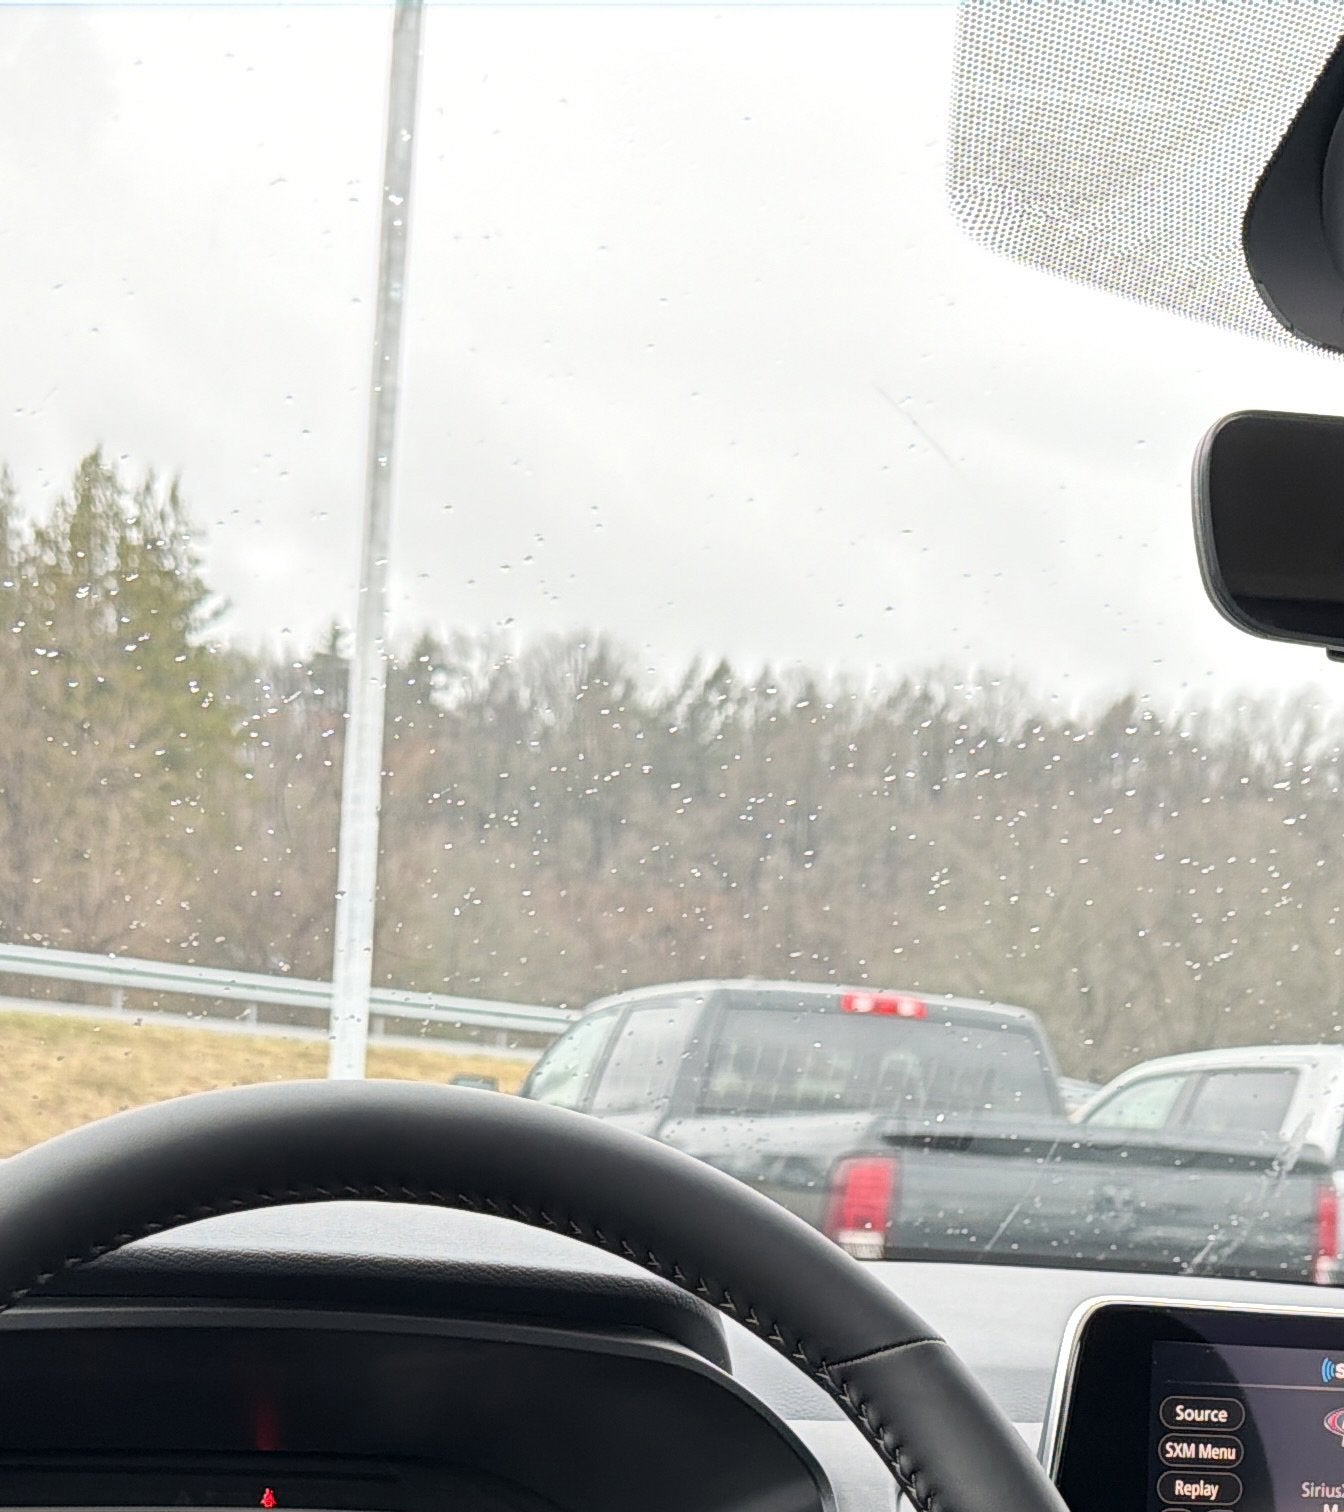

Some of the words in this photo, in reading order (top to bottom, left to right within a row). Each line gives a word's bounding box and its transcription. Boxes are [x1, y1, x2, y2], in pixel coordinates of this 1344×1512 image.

[1175, 1405, 1228, 1423] Source
[1165, 1442, 1195, 1459] SXM
[1199, 1443, 1236, 1460] Menu
[1175, 1480, 1219, 1500] Replay
